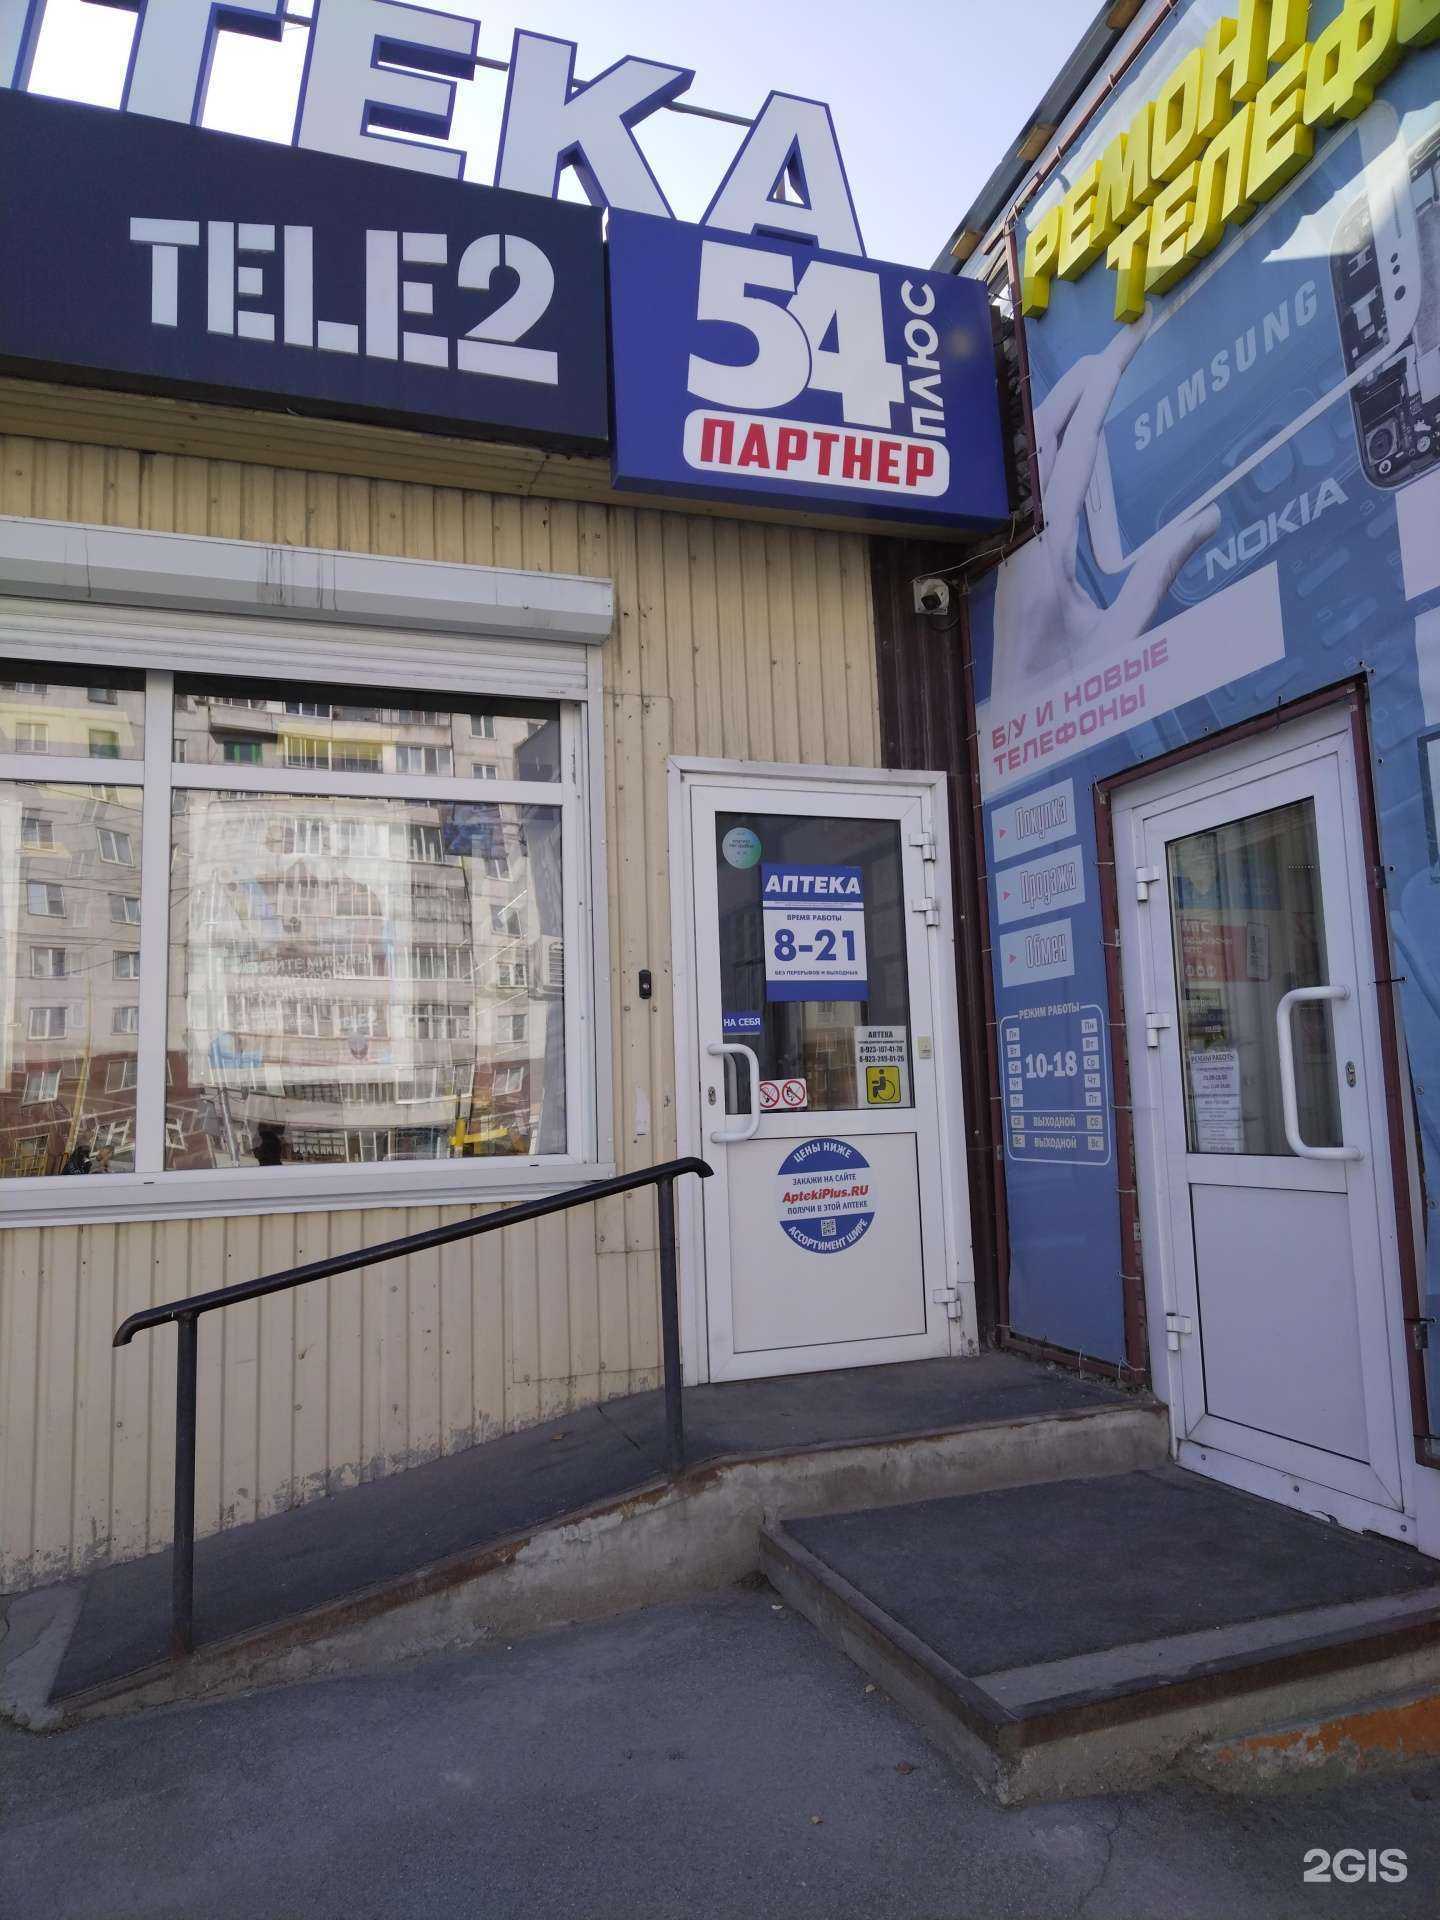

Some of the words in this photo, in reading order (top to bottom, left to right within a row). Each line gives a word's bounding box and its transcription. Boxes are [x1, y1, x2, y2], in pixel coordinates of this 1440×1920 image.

[0, 0, 867, 262] ТЕКА
[130, 216, 559, 385] TELE2
[687, 239, 905, 429] 54
[901, 279, 946, 437] ПЛЮС
[1135, 280, 1317, 450] SAMSUNG
[700, 418, 934, 487] ПАРТНЕР
[1205, 477, 1349, 581] NOKIA
[992, 713, 1026, 750] Б/У
[1036, 700, 1053, 728] И
[1064, 638, 1169, 713] НОВЫЕ
[993, 684, 1146, 775] ТЕЛЕФОНЫ
[1015, 796, 1067, 840] Покупка
[765, 874, 860, 894] АПТЕКА
[1020, 862, 1076, 909] Продажа
[774, 928, 855, 962] 8-21
[1024, 934, 1068, 968] Обмен
[1019, 1006, 1047, 1019] РЕЖИМ
[1047, 1002, 1080, 1016] РАБОТЫ
[1025, 1051, 1077, 1078] 10-18
[1033, 1114, 1076, 1128] ВЫХОДНОЙ
[793, 1143, 821, 1162] ЦЕНЫ
[823, 1142, 852, 1158] НИЖЕ
[1034, 1136, 1077, 1149] ВЫХОДНОЙ
[782, 1185, 869, 1204] AptekiPlus.RU
[792, 1176, 822, 1185] ЗАКАЖИ
[823, 1175, 834, 1183] НА
[835, 1173, 857, 1182] САЙТЕ
[787, 1205, 815, 1214] ПОЛУЧИ
[823, 1202, 840, 1212] ЭТОЙ
[788, 1226, 845, 1250] АССОРТИМЕНТ
[846, 1218, 868, 1242] ШИРЕ
